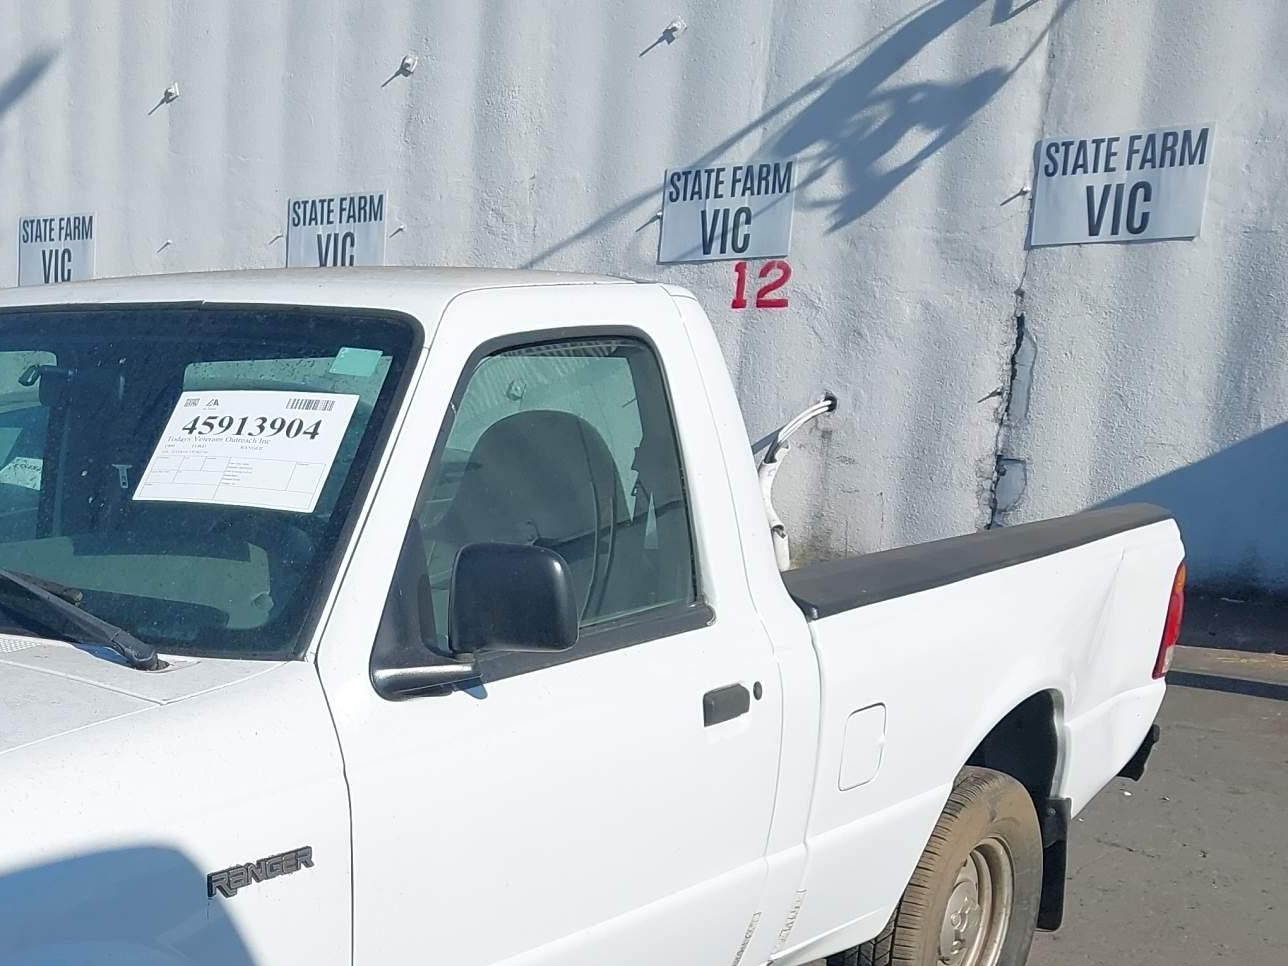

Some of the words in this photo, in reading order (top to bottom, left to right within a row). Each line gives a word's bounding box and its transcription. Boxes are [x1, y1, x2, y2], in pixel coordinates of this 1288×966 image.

[1044, 137, 1120, 178] STATE
[1126, 127, 1209, 171] FARM
[669, 167, 726, 203] STATE
[730, 161, 793, 198] FARM
[22, 217, 55, 243] STATE
[58, 215, 93, 241] FARM
[292, 198, 335, 227] STATE
[338, 194, 384, 224] FARM
[1086, 180, 1152, 237] VIC
[316, 231, 355, 267] VIC
[700, 206, 752, 256] VIC
[41, 248, 72, 284] VIC
[731, 260, 792, 309] 12
[182, 415, 323, 440] 45913904
[207, 845, 315, 899] RANGER
